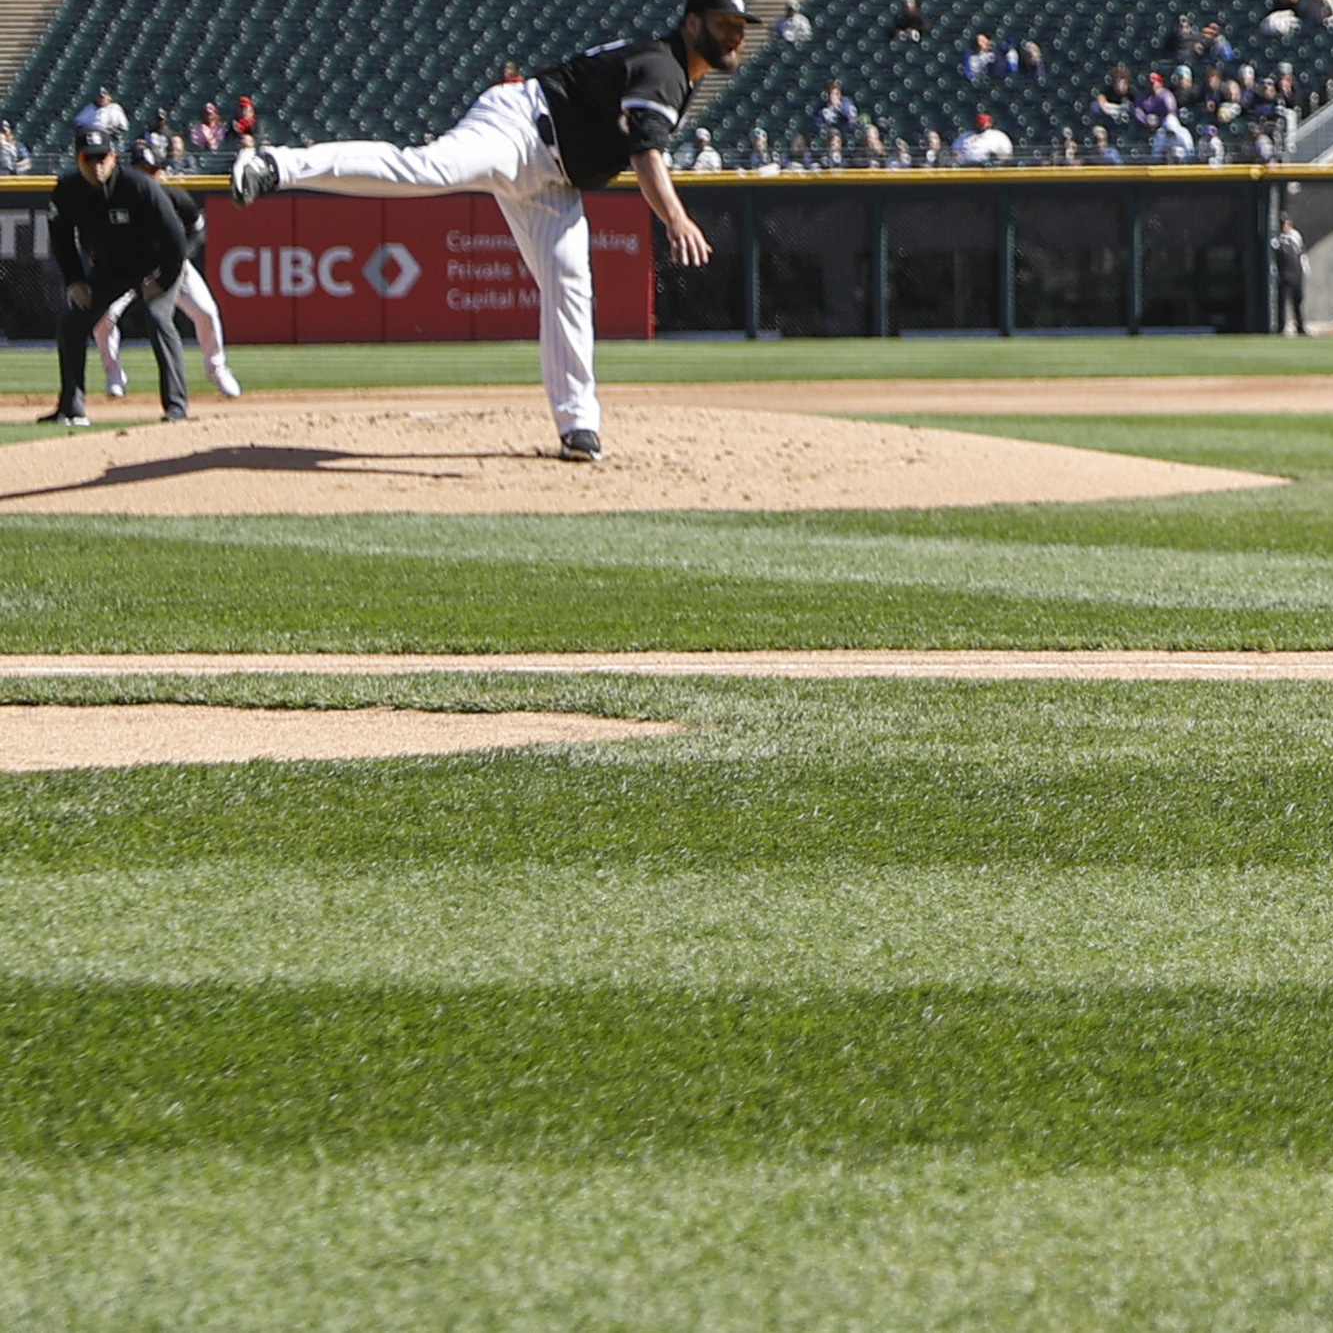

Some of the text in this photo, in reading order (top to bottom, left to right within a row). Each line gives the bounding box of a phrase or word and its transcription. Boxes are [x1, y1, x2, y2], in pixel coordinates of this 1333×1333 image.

[219, 245, 355, 297] CIBC
[447, 259, 513, 282] Private
[446, 288, 515, 312] Capital
